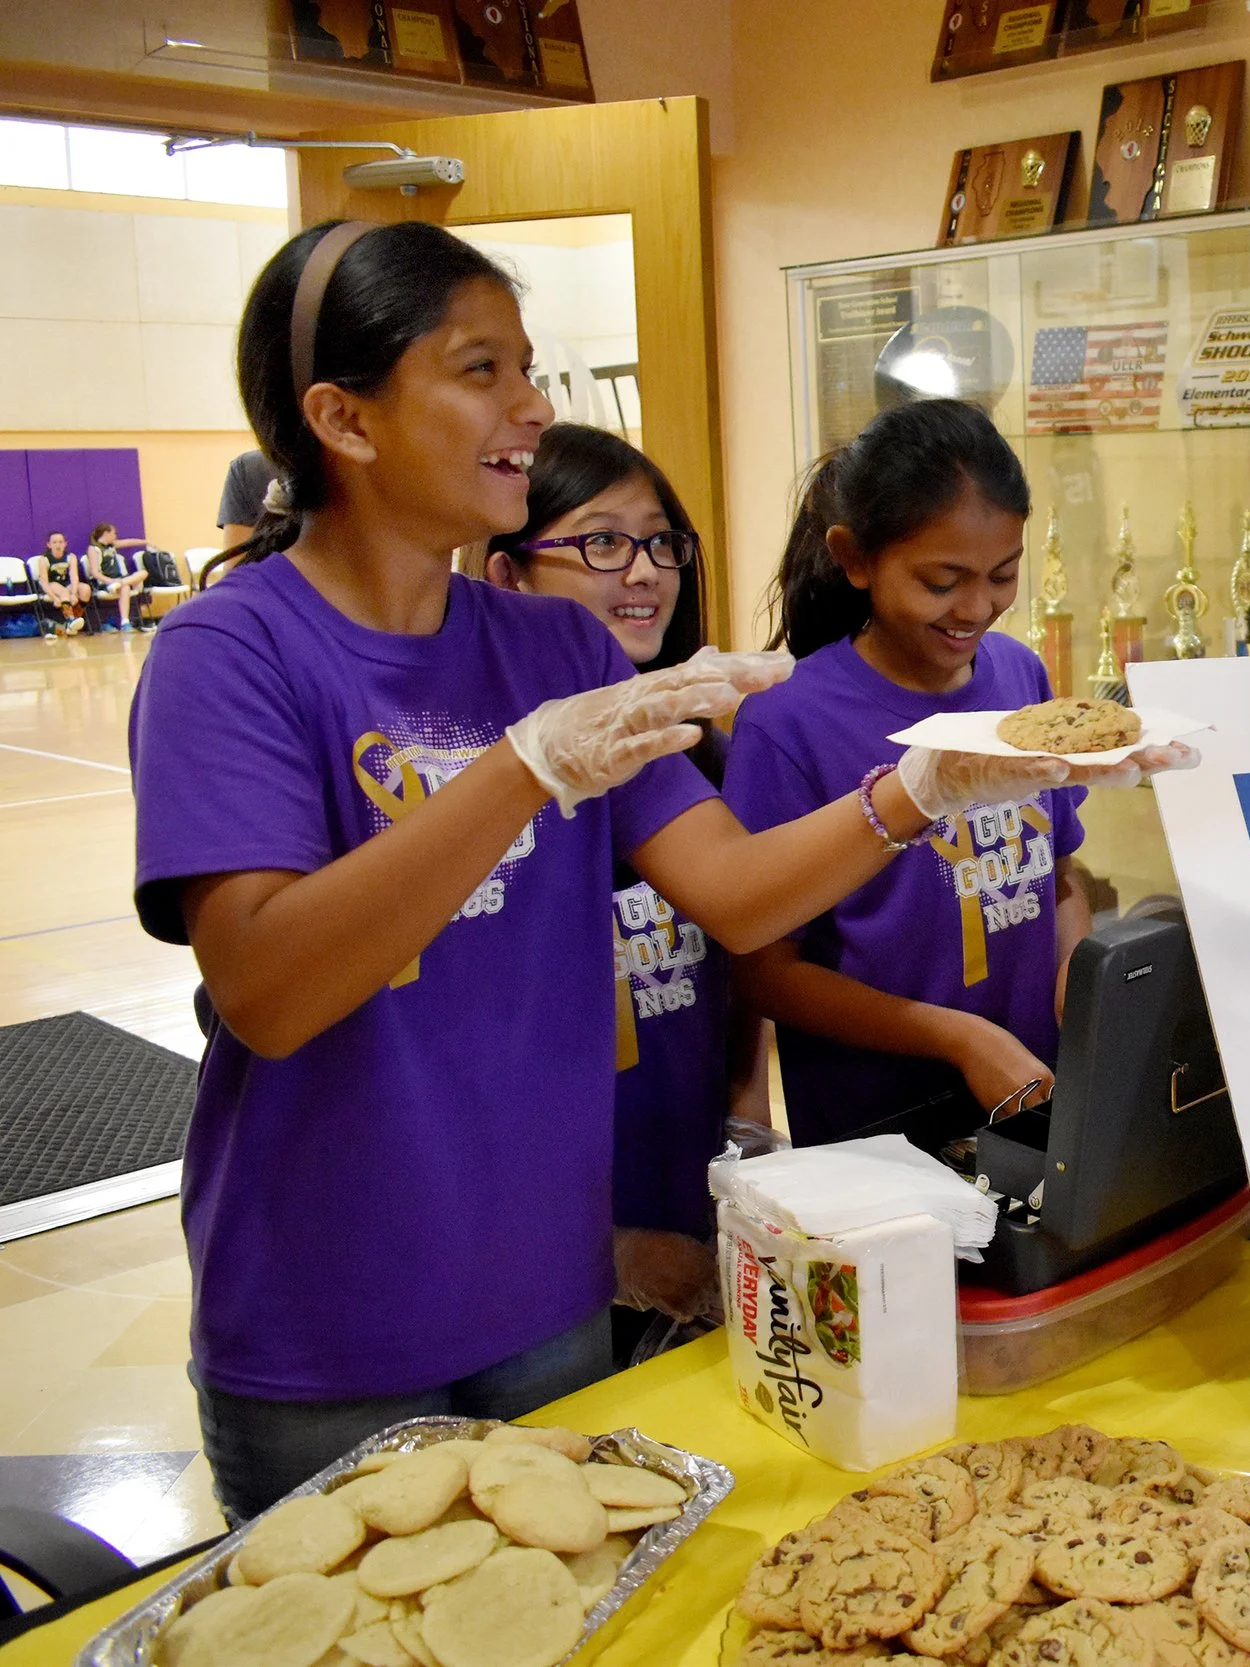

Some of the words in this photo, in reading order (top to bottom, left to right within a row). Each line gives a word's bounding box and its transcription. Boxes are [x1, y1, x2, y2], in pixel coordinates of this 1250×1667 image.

[973, 800, 1024, 848] GO
[954, 837, 1054, 899] GOLD
[618, 889, 675, 931] GO
[983, 891, 1041, 934] NGS
[634, 978, 696, 1019] NGS
[739, 1238, 758, 1346] EVERYDAY
